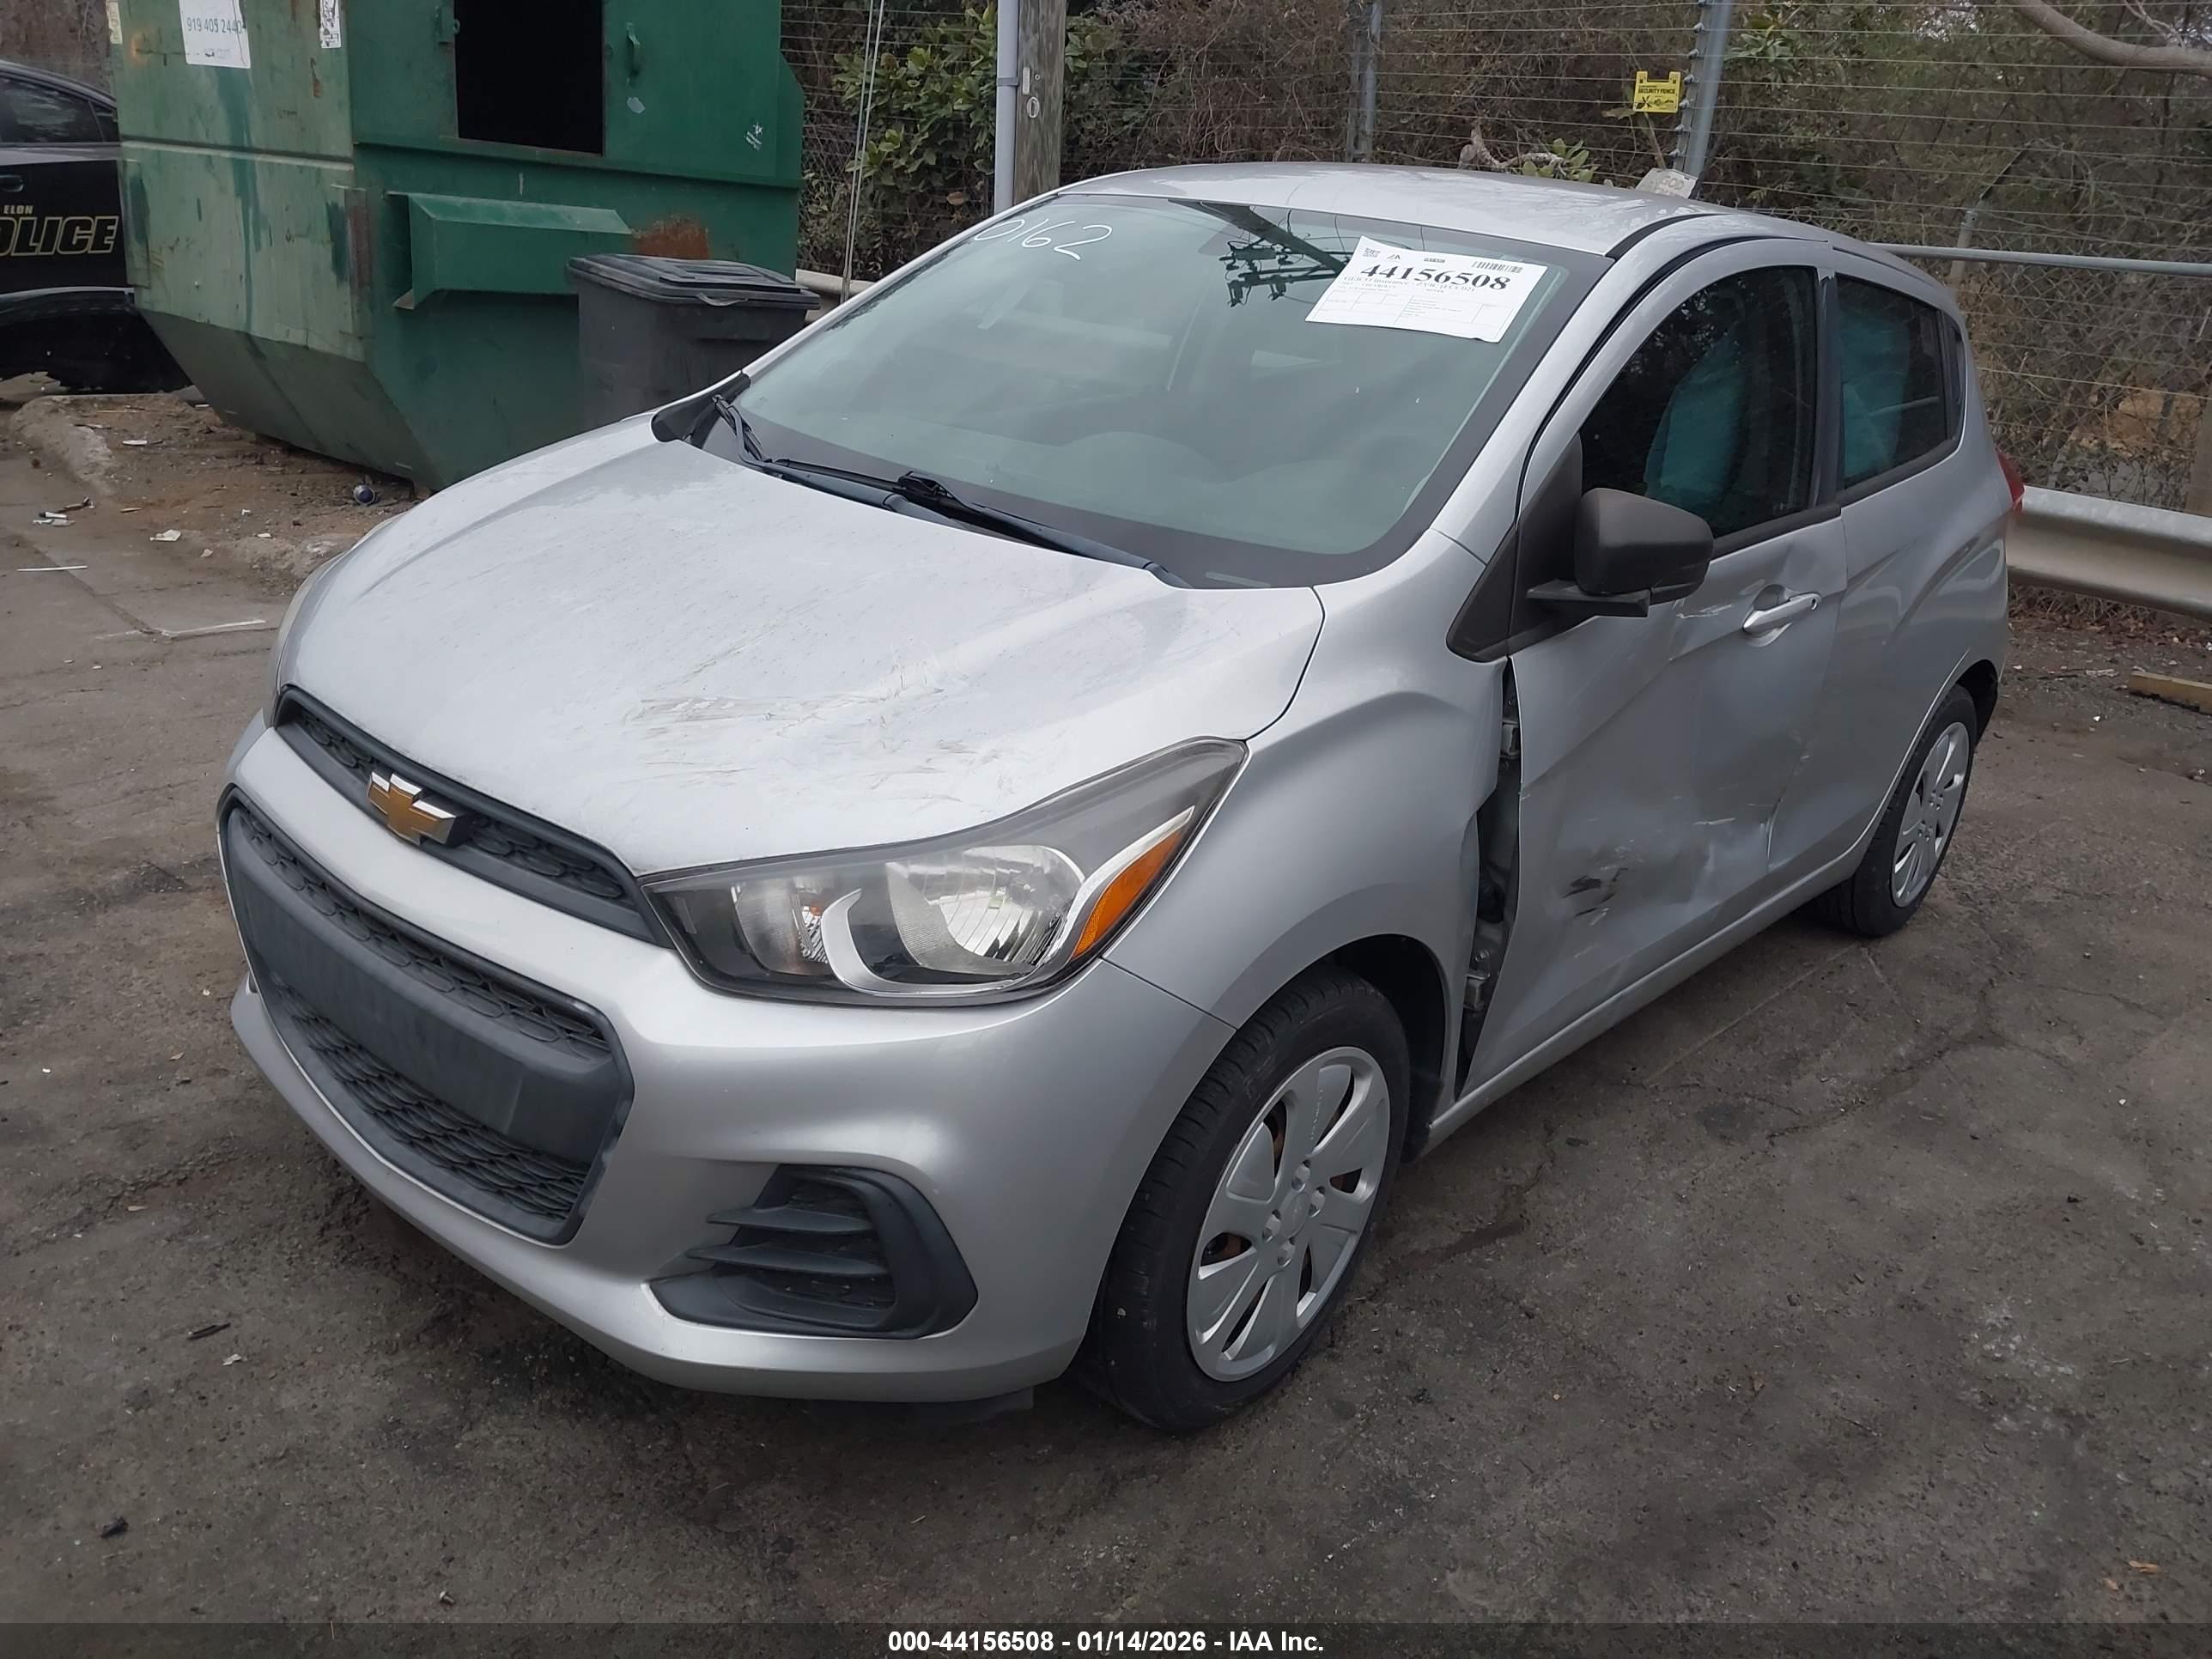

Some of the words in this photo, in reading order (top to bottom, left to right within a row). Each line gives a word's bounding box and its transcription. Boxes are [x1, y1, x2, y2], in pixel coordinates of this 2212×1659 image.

[3, 205, 33, 215] ELON
[974, 218, 1112, 260] 0162
[1360, 264, 1511, 290] 44156508
